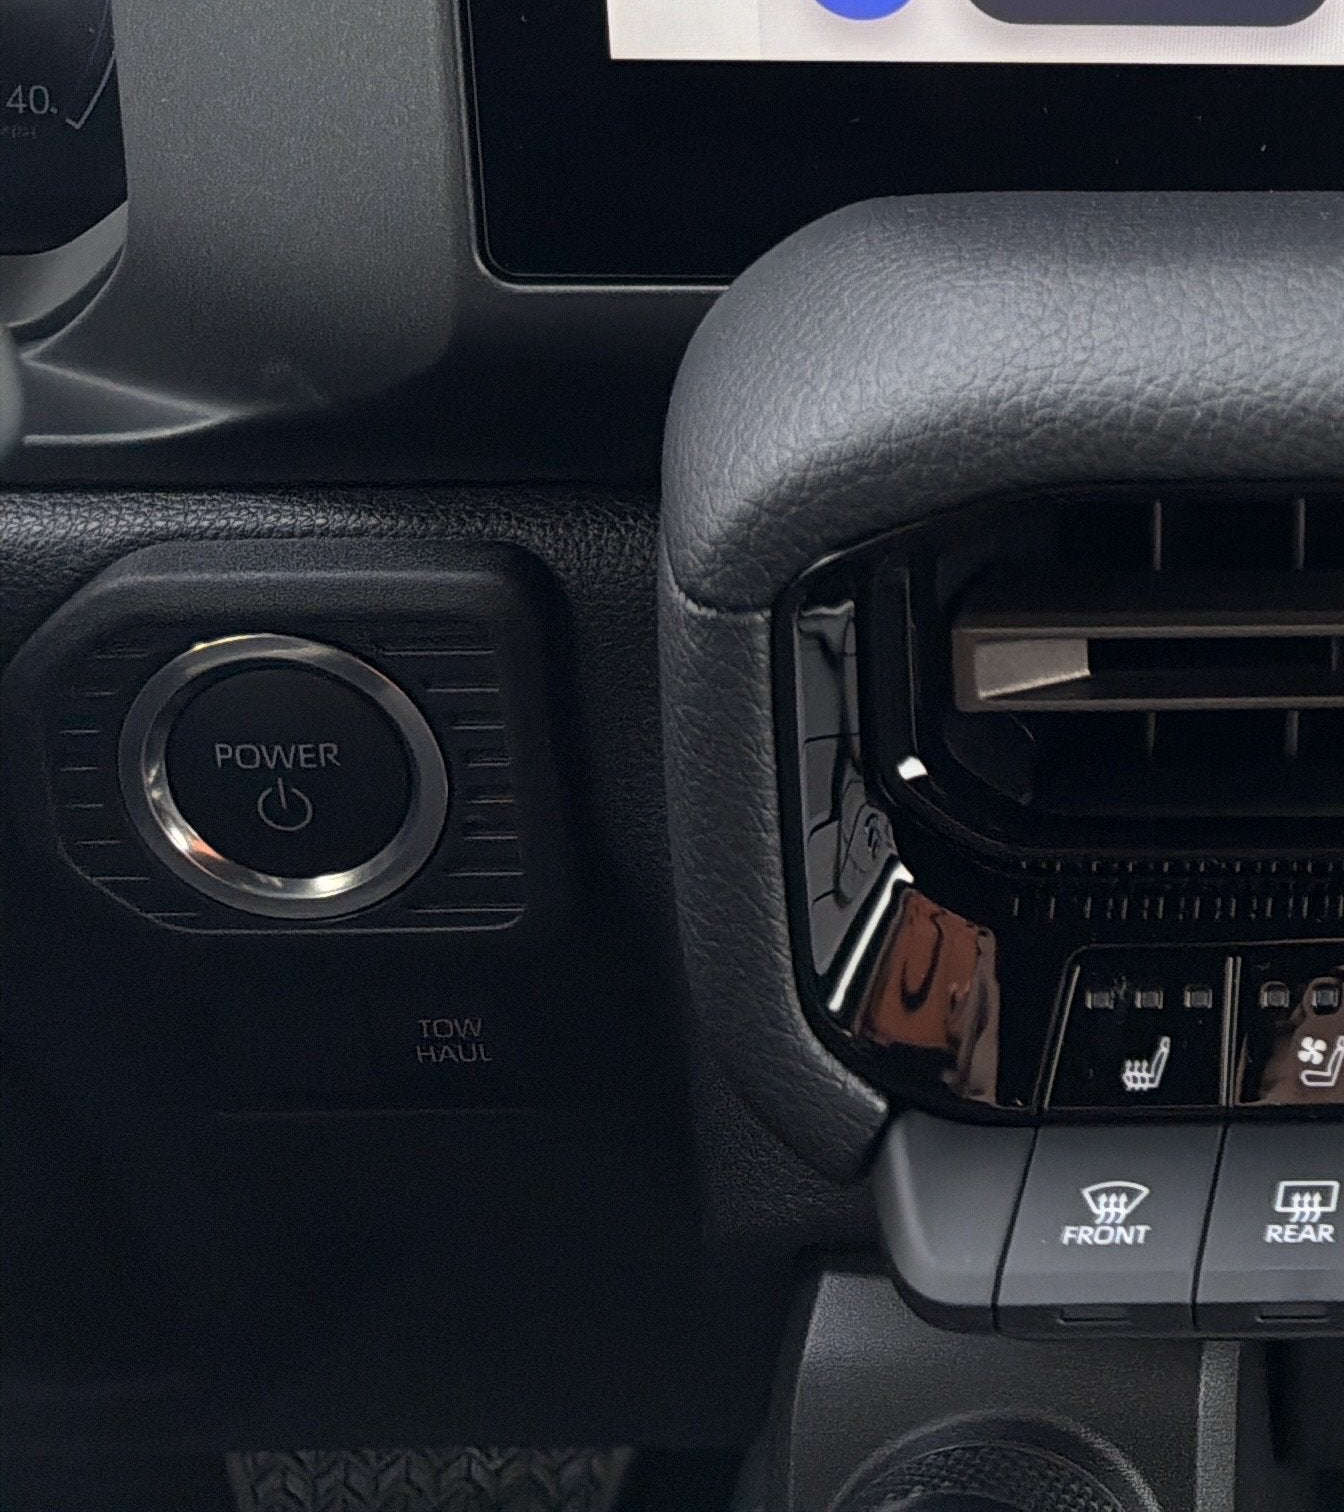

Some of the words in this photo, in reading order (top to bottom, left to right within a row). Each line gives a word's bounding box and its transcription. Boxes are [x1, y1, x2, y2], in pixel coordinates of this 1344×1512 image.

[214, 742, 341, 769] POWER
[417, 1017, 482, 1040] TOW
[415, 1043, 493, 1064] HAUL
[1061, 1221, 1151, 1245] FRONT
[1264, 1223, 1335, 1244] REAR
